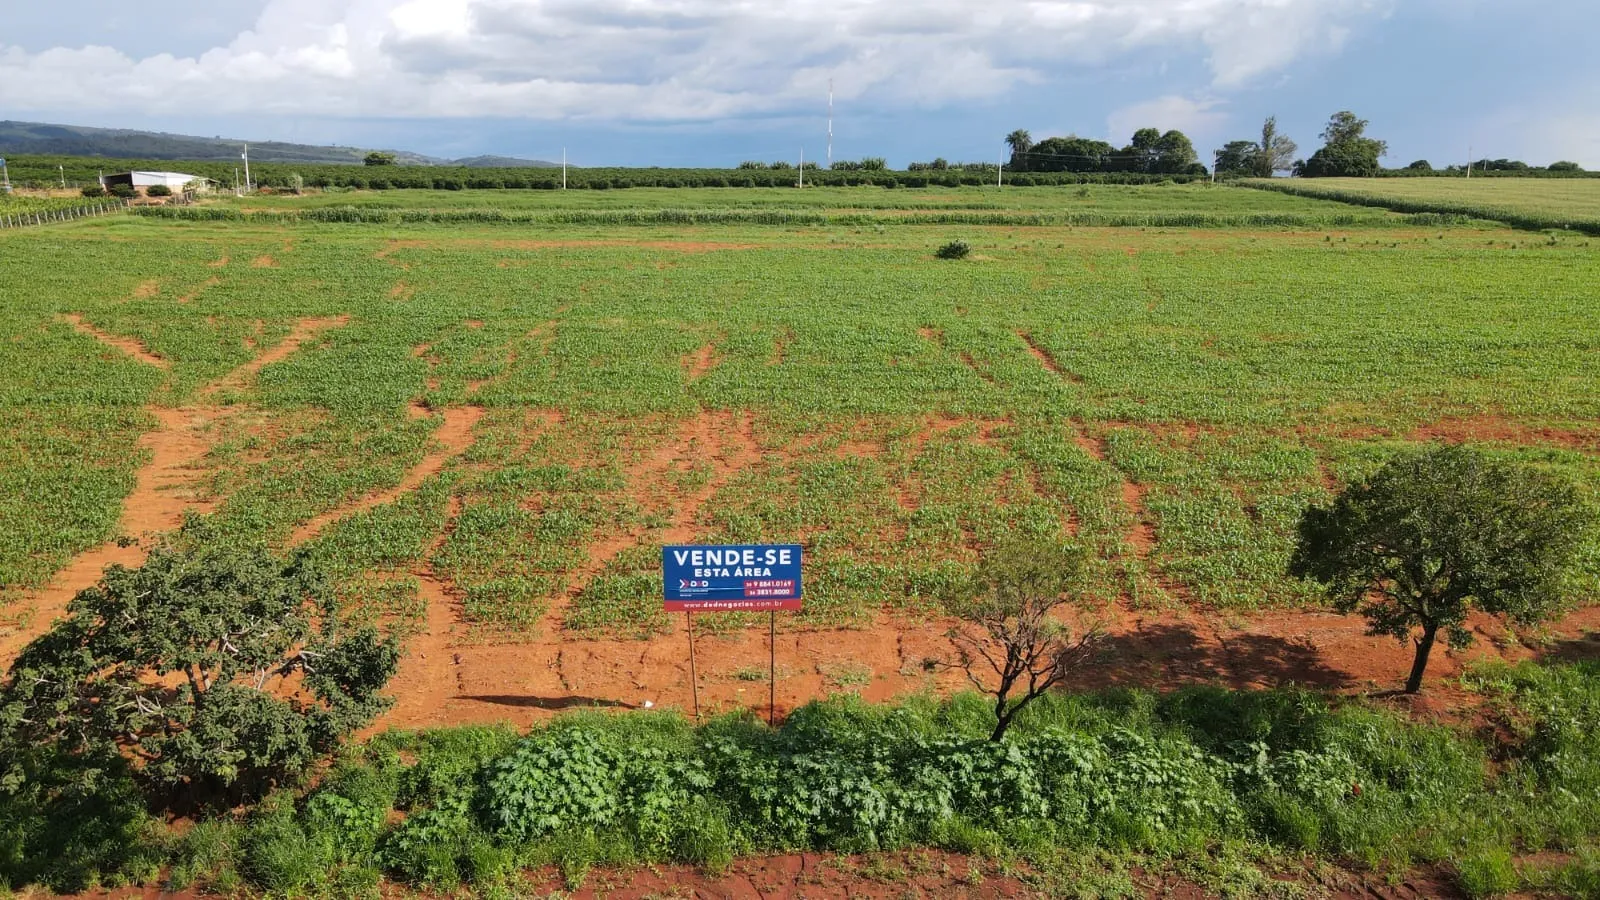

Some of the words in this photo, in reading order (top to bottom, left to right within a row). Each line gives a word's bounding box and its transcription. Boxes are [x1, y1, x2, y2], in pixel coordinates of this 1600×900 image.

[674, 550, 791, 566] VENDE-SE
[695, 568, 730, 577] ESTA
[734, 566, 772, 576] ÁREA
